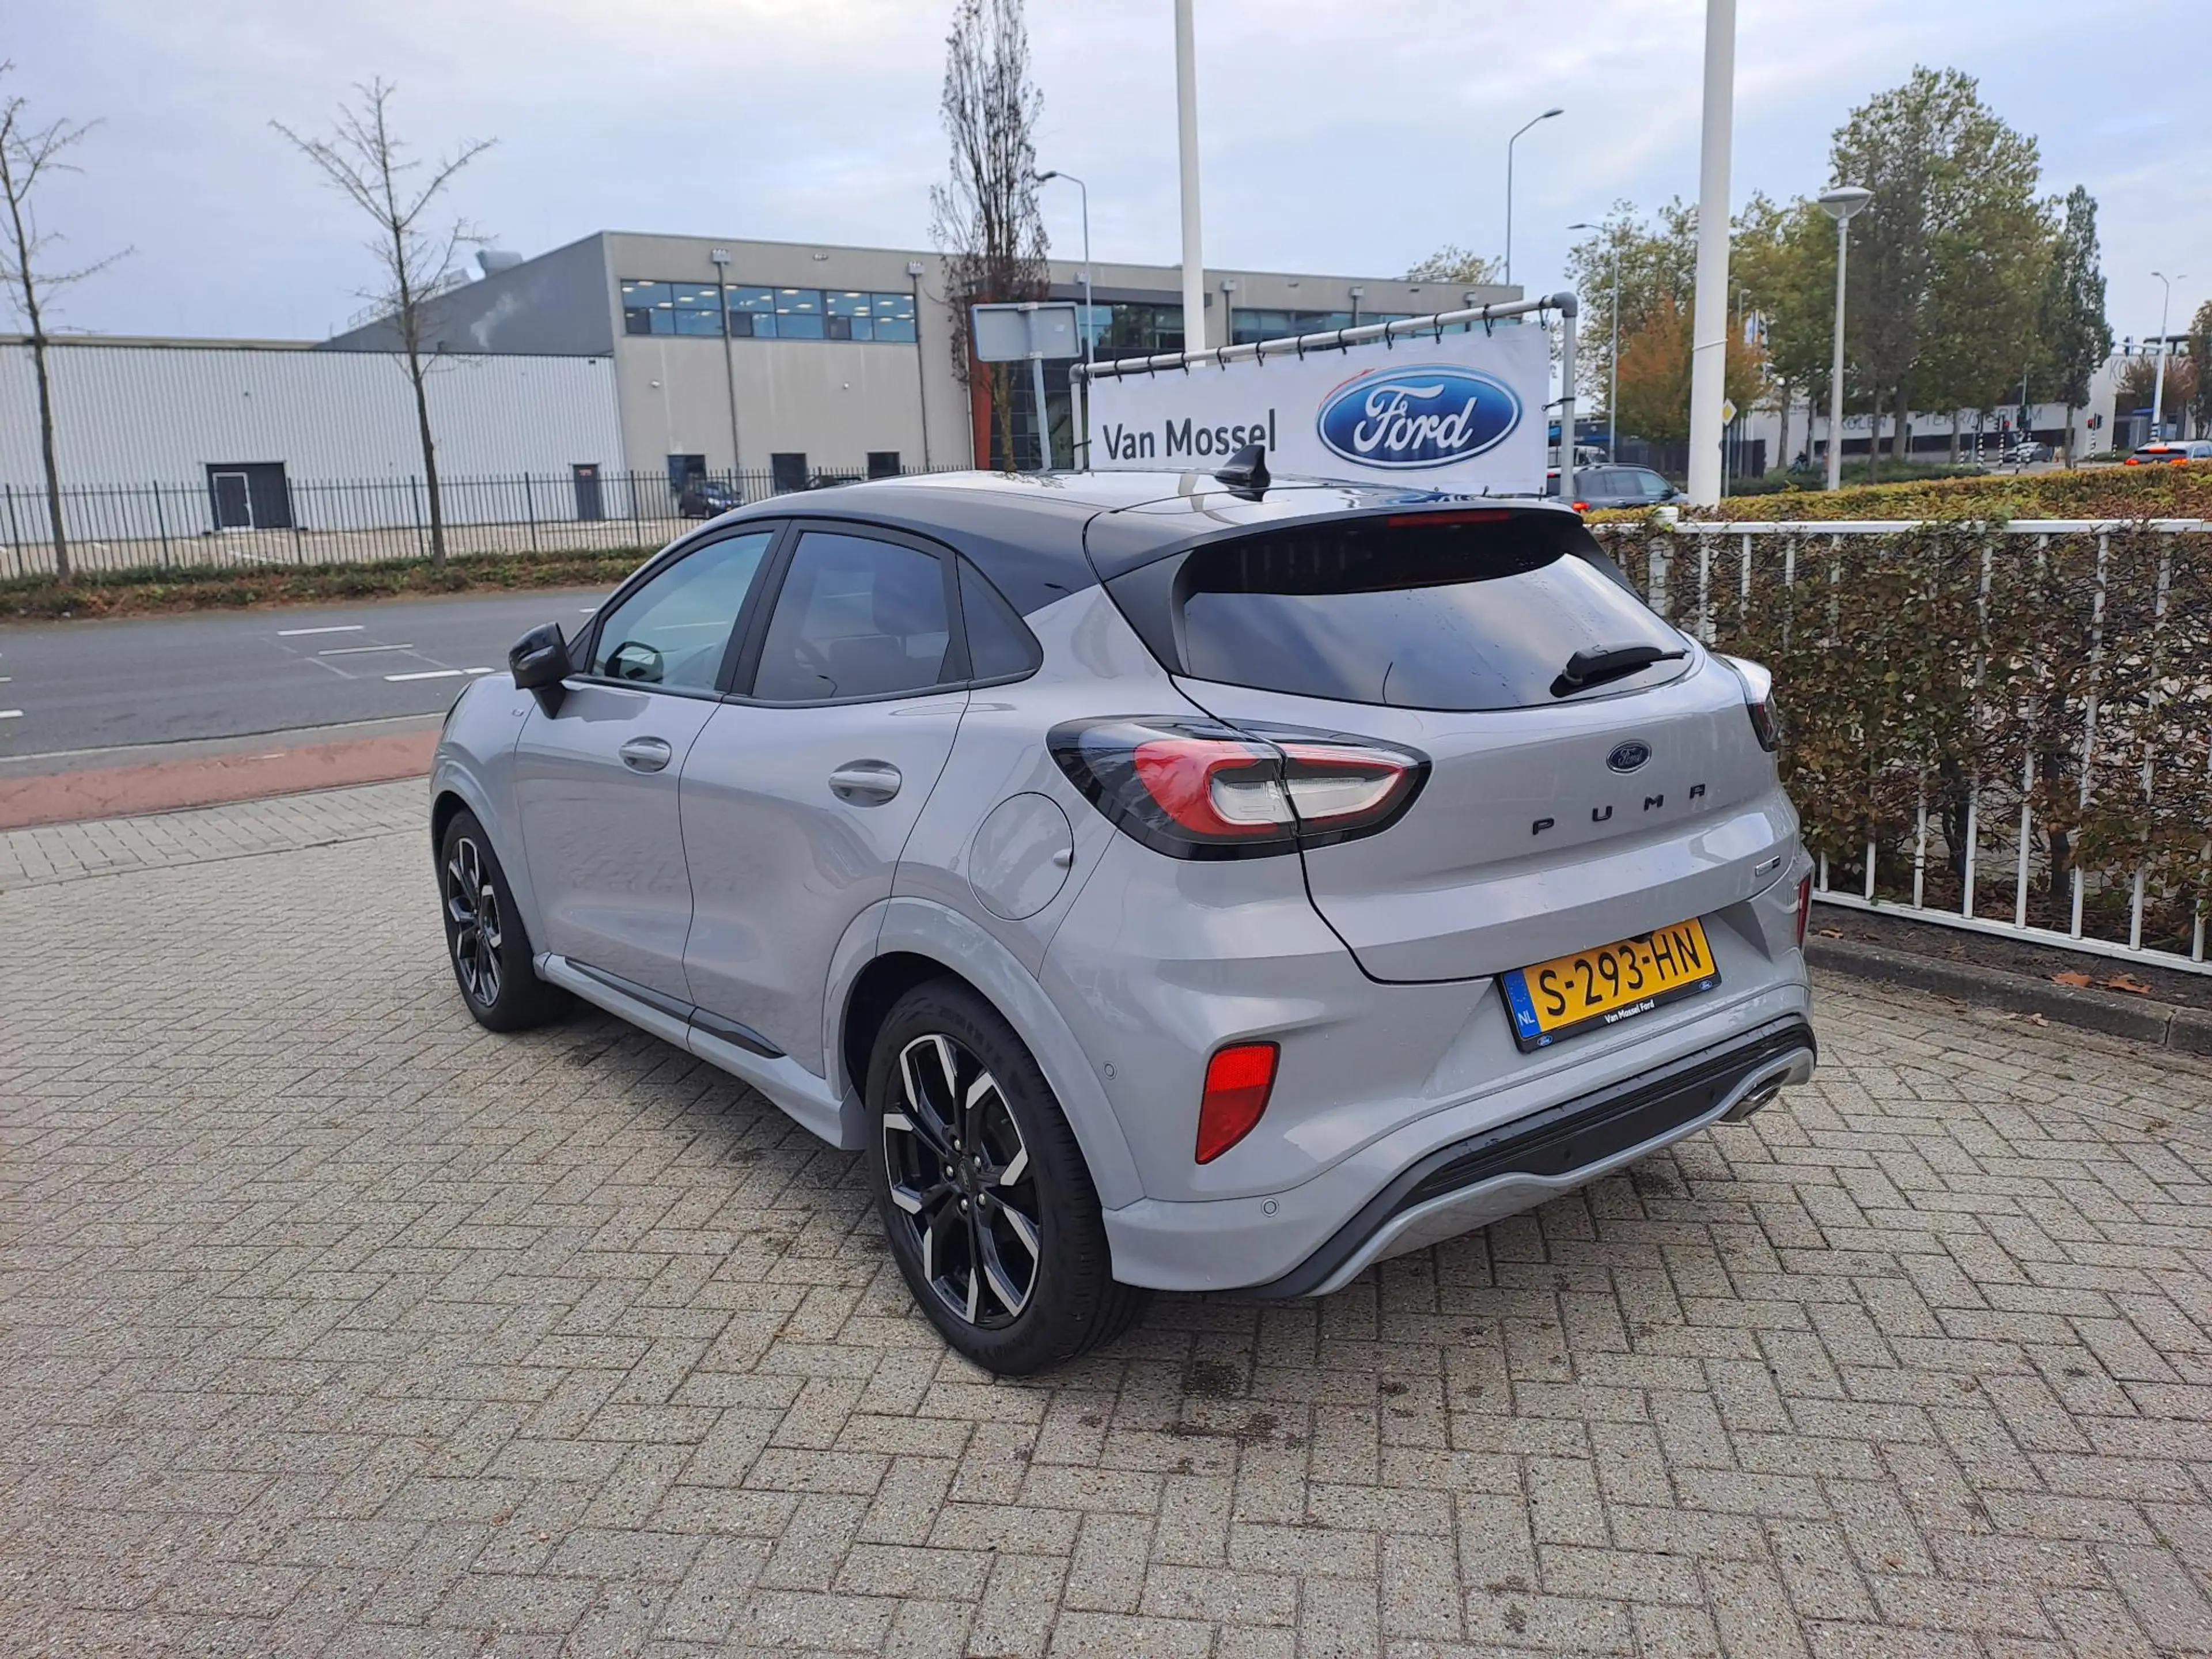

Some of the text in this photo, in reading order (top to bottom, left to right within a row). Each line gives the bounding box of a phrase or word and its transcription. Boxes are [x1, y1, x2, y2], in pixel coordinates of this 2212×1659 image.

[1103, 408, 1276, 460] Van Mossel
[1353, 384, 1478, 452] Ford
[1532, 783, 1706, 835] PUMA
[1539, 927, 1702, 1017] S-293-HN
[1517, 1009, 1536, 1027] NL
[1604, 998, 1654, 1024] Van Mossel Ford
